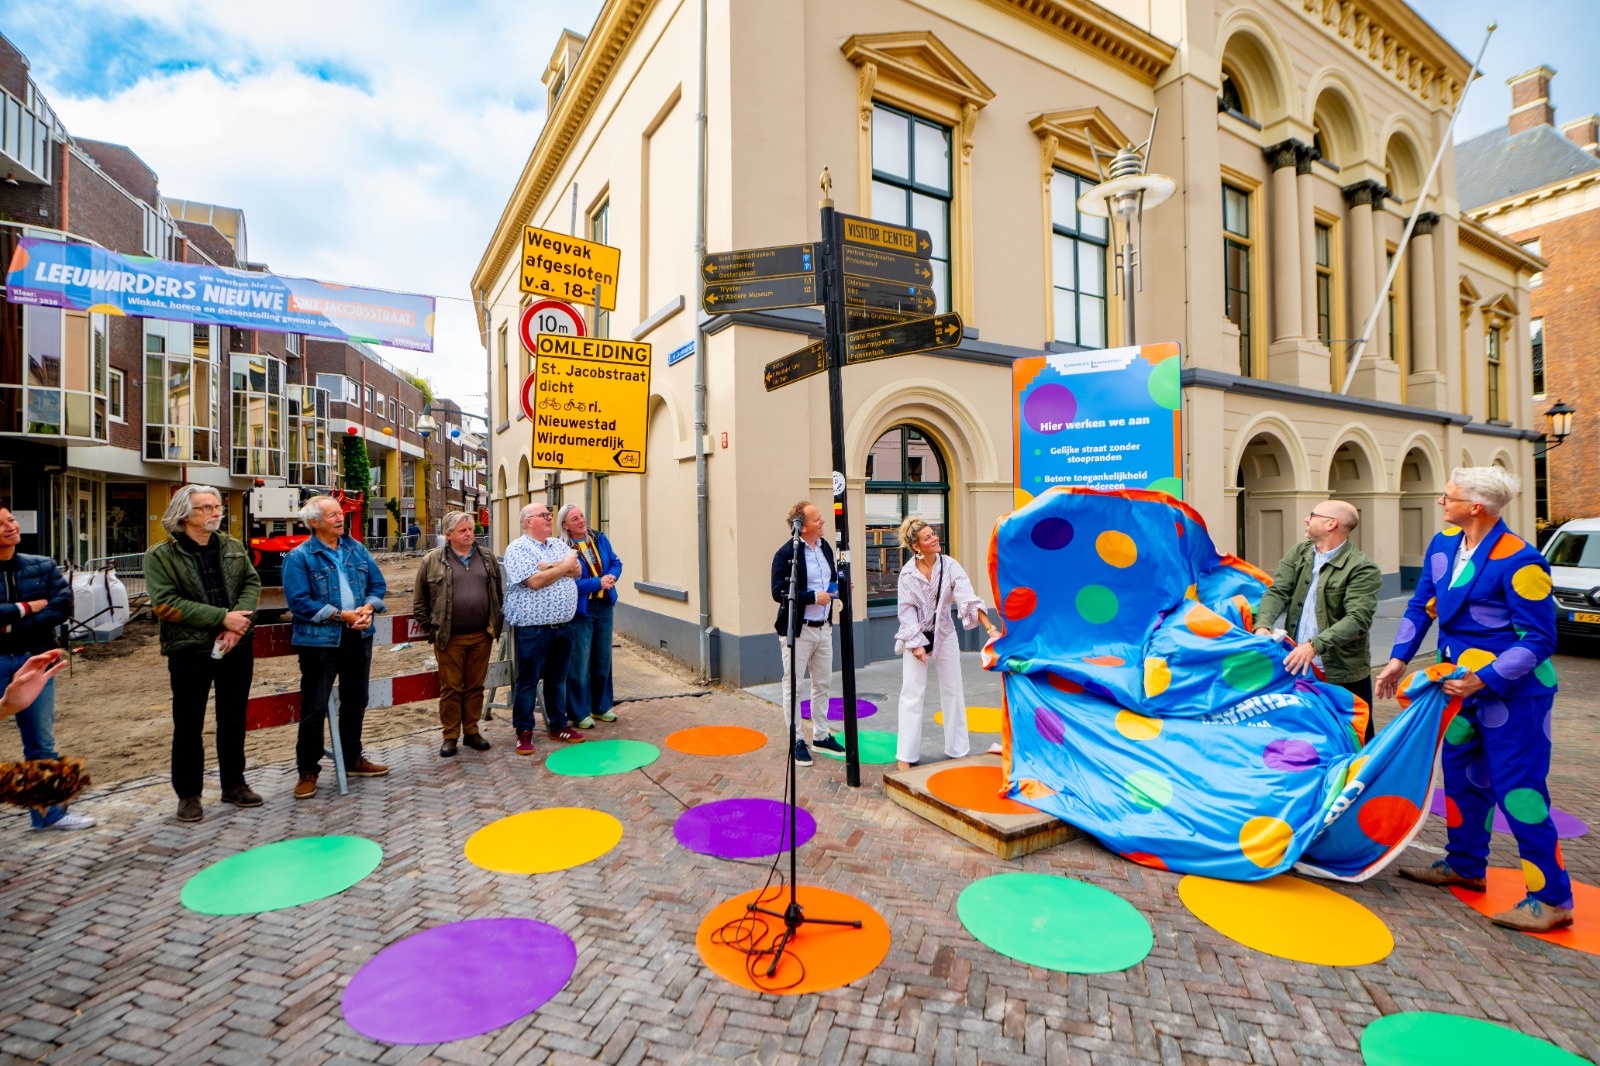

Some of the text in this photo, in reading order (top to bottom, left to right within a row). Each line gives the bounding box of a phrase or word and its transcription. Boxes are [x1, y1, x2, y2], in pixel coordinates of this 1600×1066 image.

[848, 222, 914, 248] VISITOR CENTER
[528, 231, 591, 259] Wegvak
[526, 254, 612, 285] afgesloten
[35, 262, 196, 299] LEEUWARDERS
[216, 276, 248, 288] werken
[524, 276, 554, 292] v.a.
[13, 289, 36, 298] Klaar:
[203, 284, 284, 310] NIEUWE
[40, 298, 58, 306] 2026
[294, 296, 411, 324] SINT JACOBSSTRAAT
[128, 297, 167, 308] Winkels,
[170, 301, 201, 312] horeca
[218, 308, 280, 322] fietsenstalling
[282, 316, 316, 326] gewoon
[540, 338, 647, 362] OMLEIDING
[850, 338, 894, 350] Natuurmuseum
[850, 350, 884, 360] Prinsentuin
[541, 362, 646, 382] St. Jacobstraat
[540, 381, 574, 393] dicht
[588, 401, 602, 412] ri.
[538, 414, 616, 430] Nieuwestad
[1040, 416, 1150, 432] Hier werken we aan
[538, 432, 624, 450] Wirdumerdijk
[1050, 442, 1140, 456] Gelijke straat zonder
[536, 450, 564, 464] volg
[1067, 453, 1122, 464] stoepranden
[1074, 470, 1148, 482] toegankelijkheid
